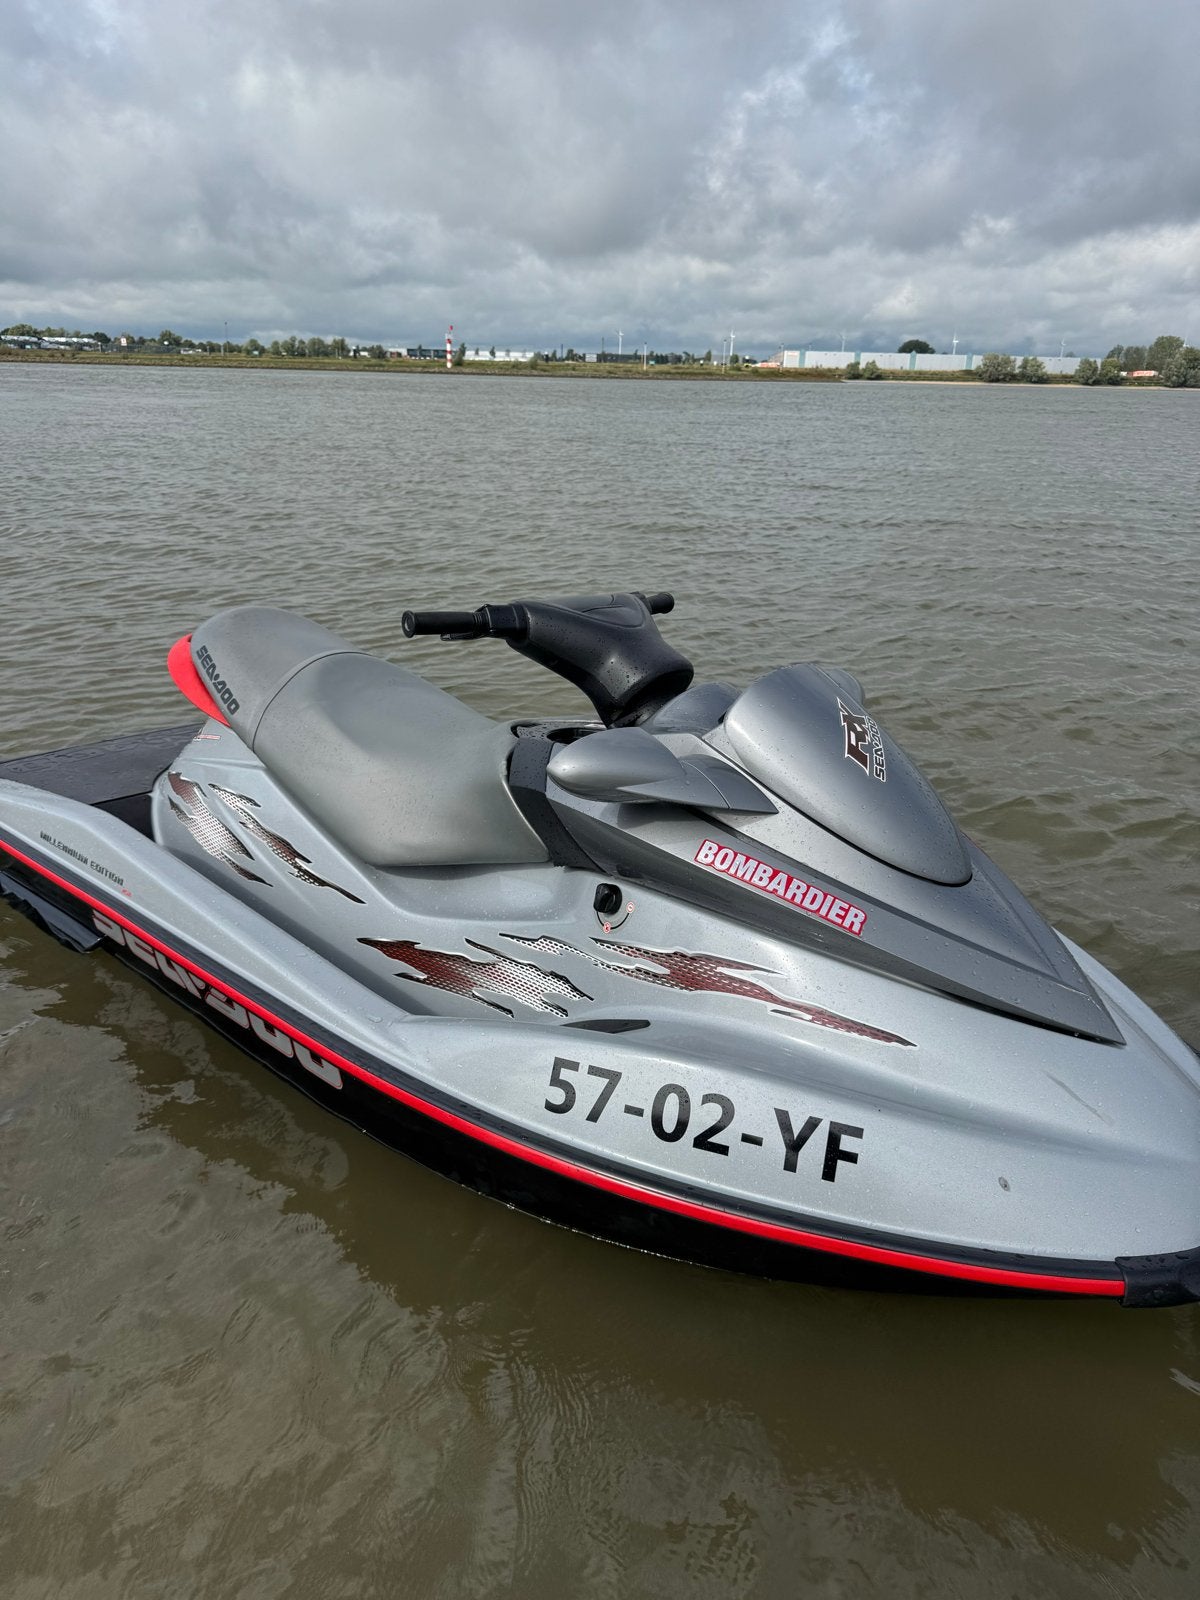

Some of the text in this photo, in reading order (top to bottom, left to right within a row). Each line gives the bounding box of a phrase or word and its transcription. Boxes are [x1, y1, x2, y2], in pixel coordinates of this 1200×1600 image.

[90, 861, 124, 886] EDITION
[694, 839, 867, 936] BOMBARDIER
[544, 1056, 864, 1182] 57-02-YF
